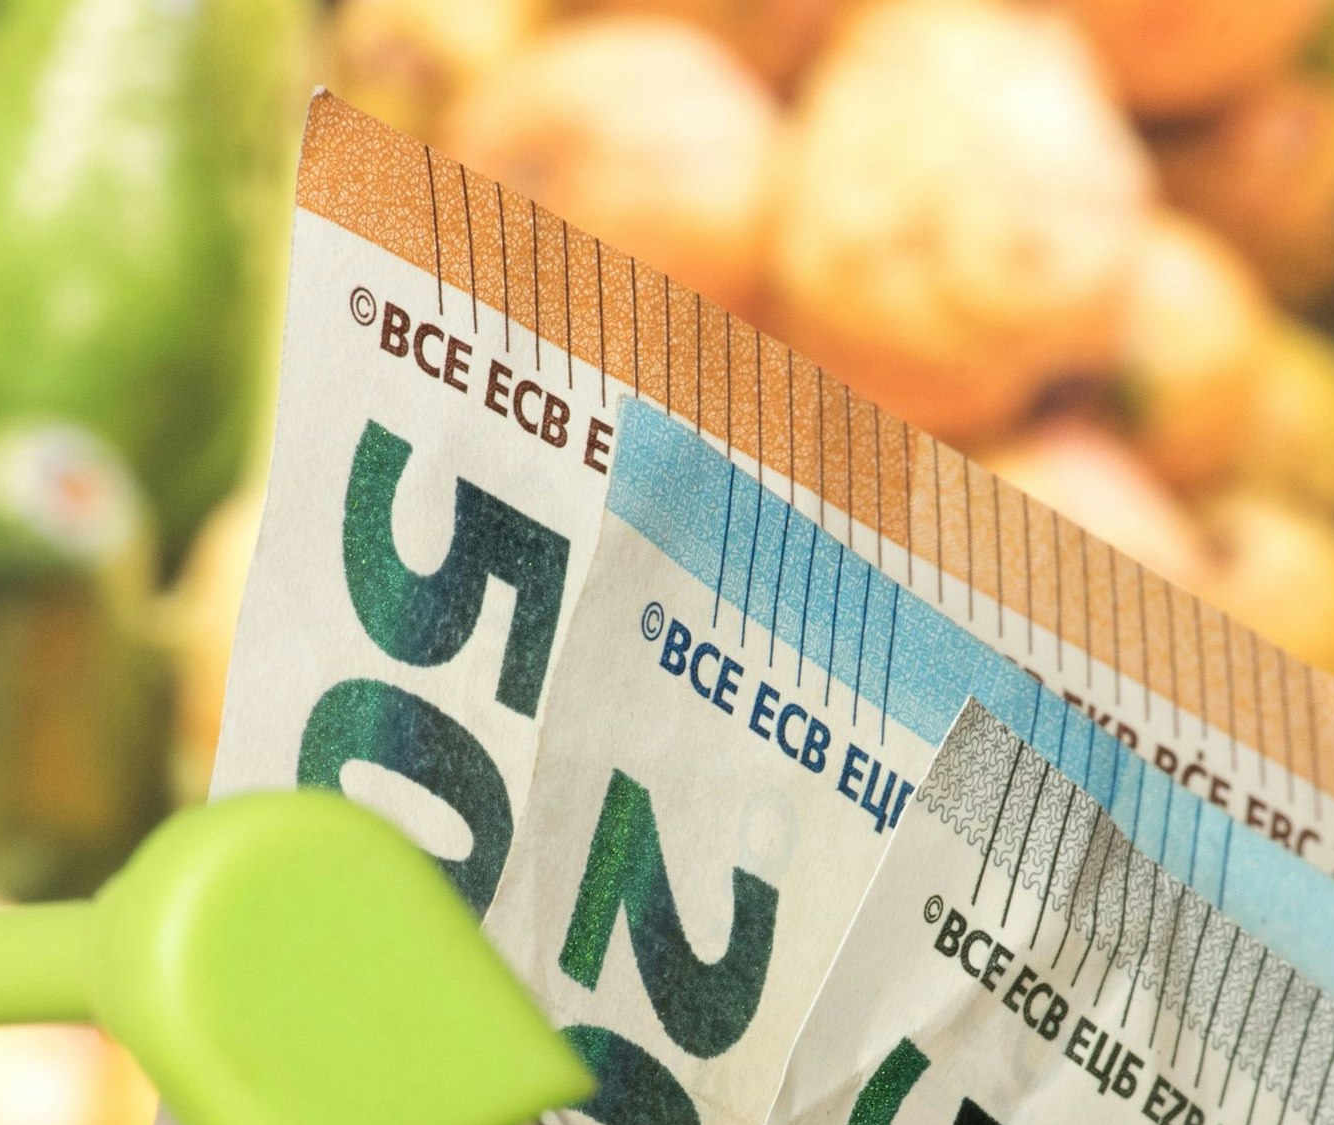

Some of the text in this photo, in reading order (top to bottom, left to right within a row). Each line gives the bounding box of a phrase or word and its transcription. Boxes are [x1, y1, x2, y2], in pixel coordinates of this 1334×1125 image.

[484, 359, 571, 449] ECB
[749, 681, 832, 774] ECB
[1002, 965, 1070, 1043] ECB
